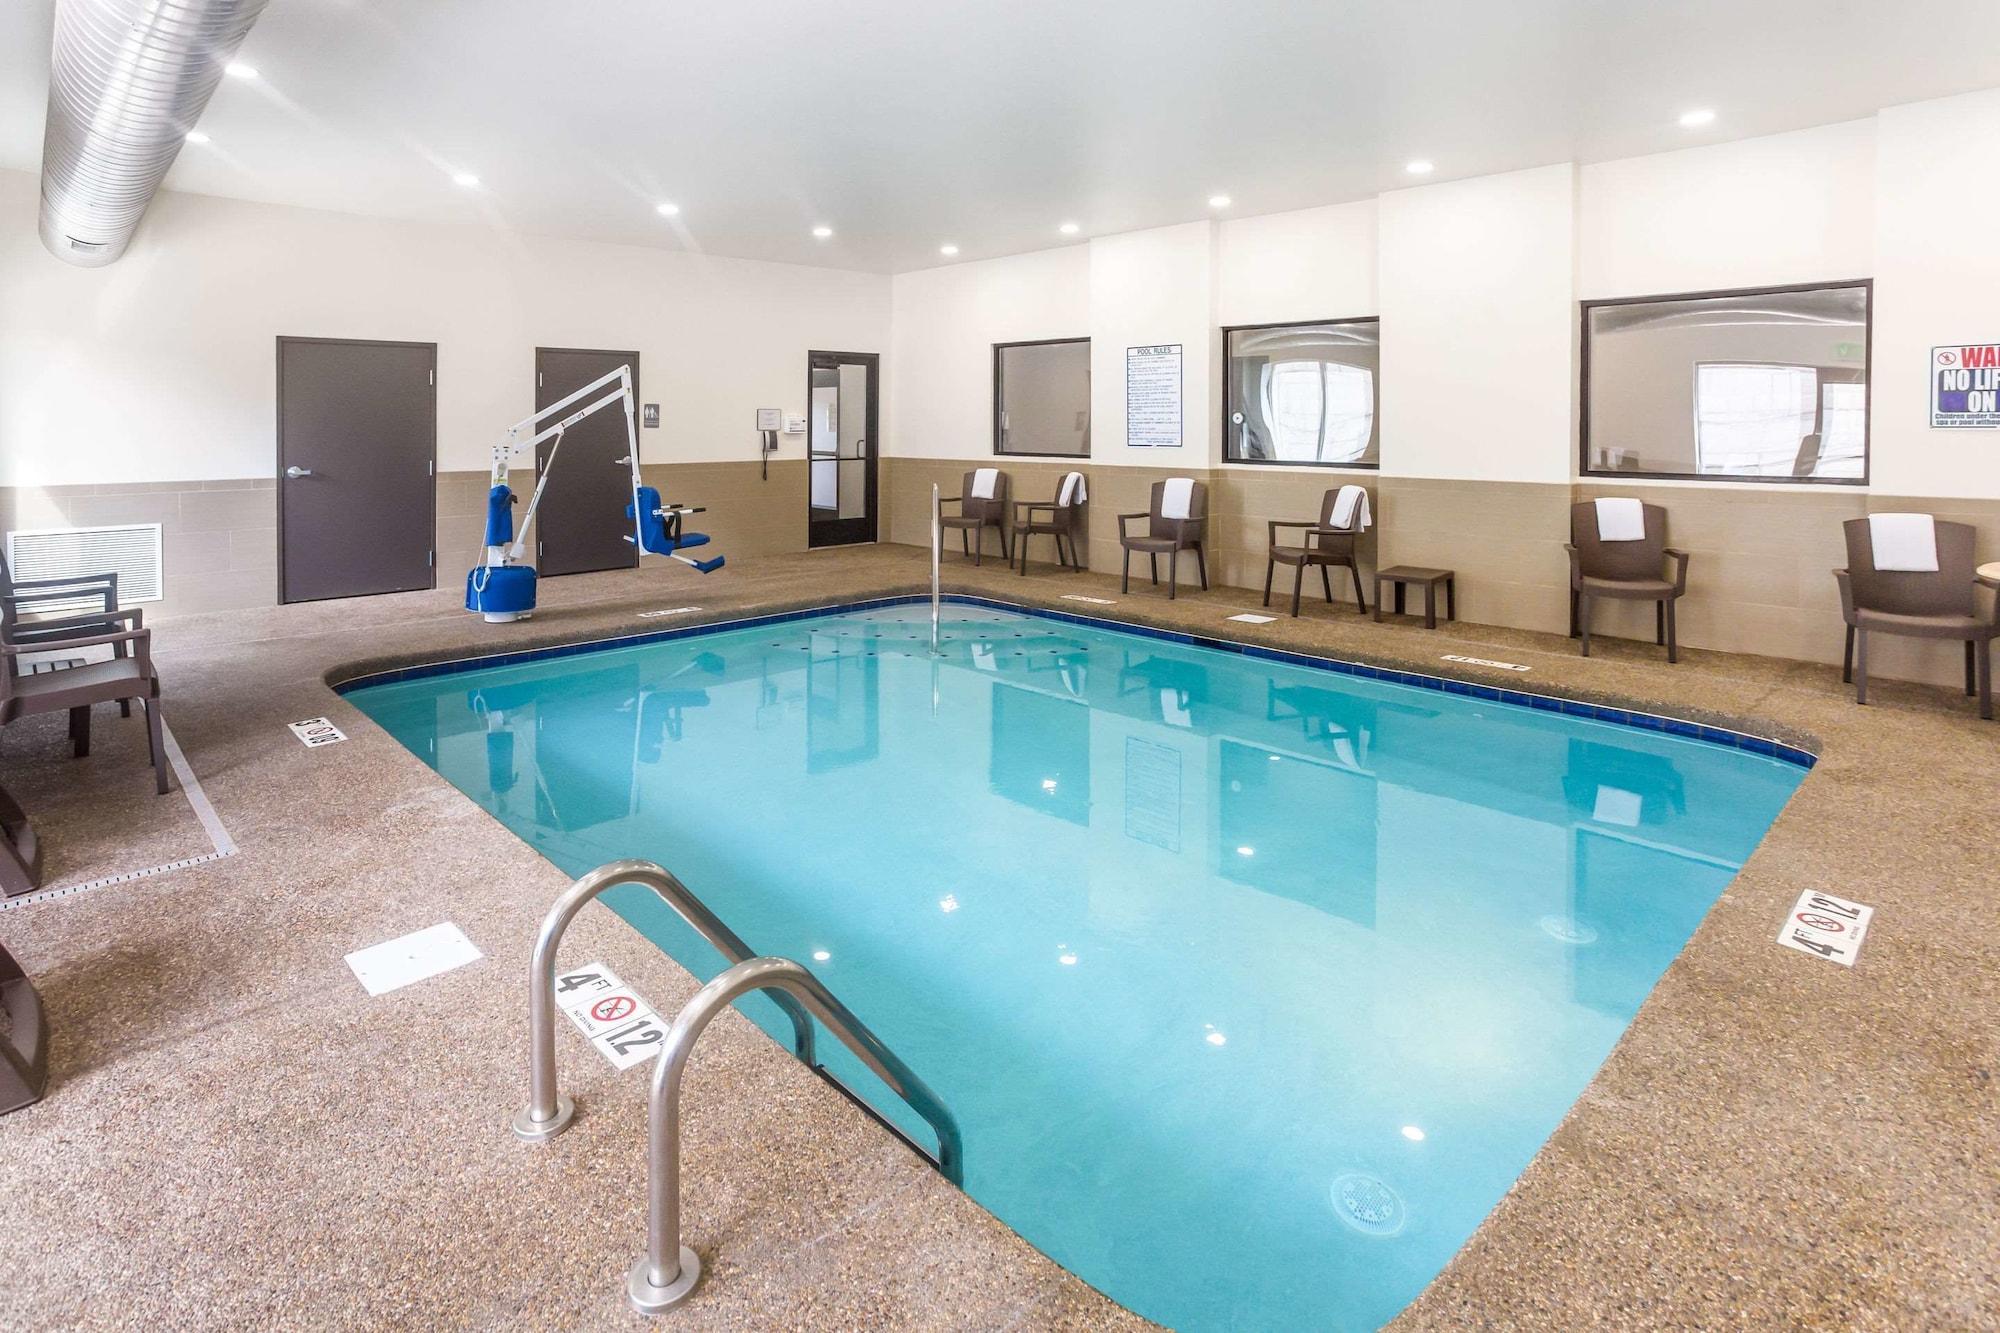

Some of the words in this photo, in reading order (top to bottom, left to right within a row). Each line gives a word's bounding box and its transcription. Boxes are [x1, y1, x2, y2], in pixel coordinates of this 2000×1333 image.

[1961, 347, 2000, 368] WA
[1943, 369, 1970, 391] NO
[1967, 390, 1996, 412] ON
[1791, 935, 1845, 957] 4
[557, 973, 602, 993] 4
[591, 979, 613, 991] FT
